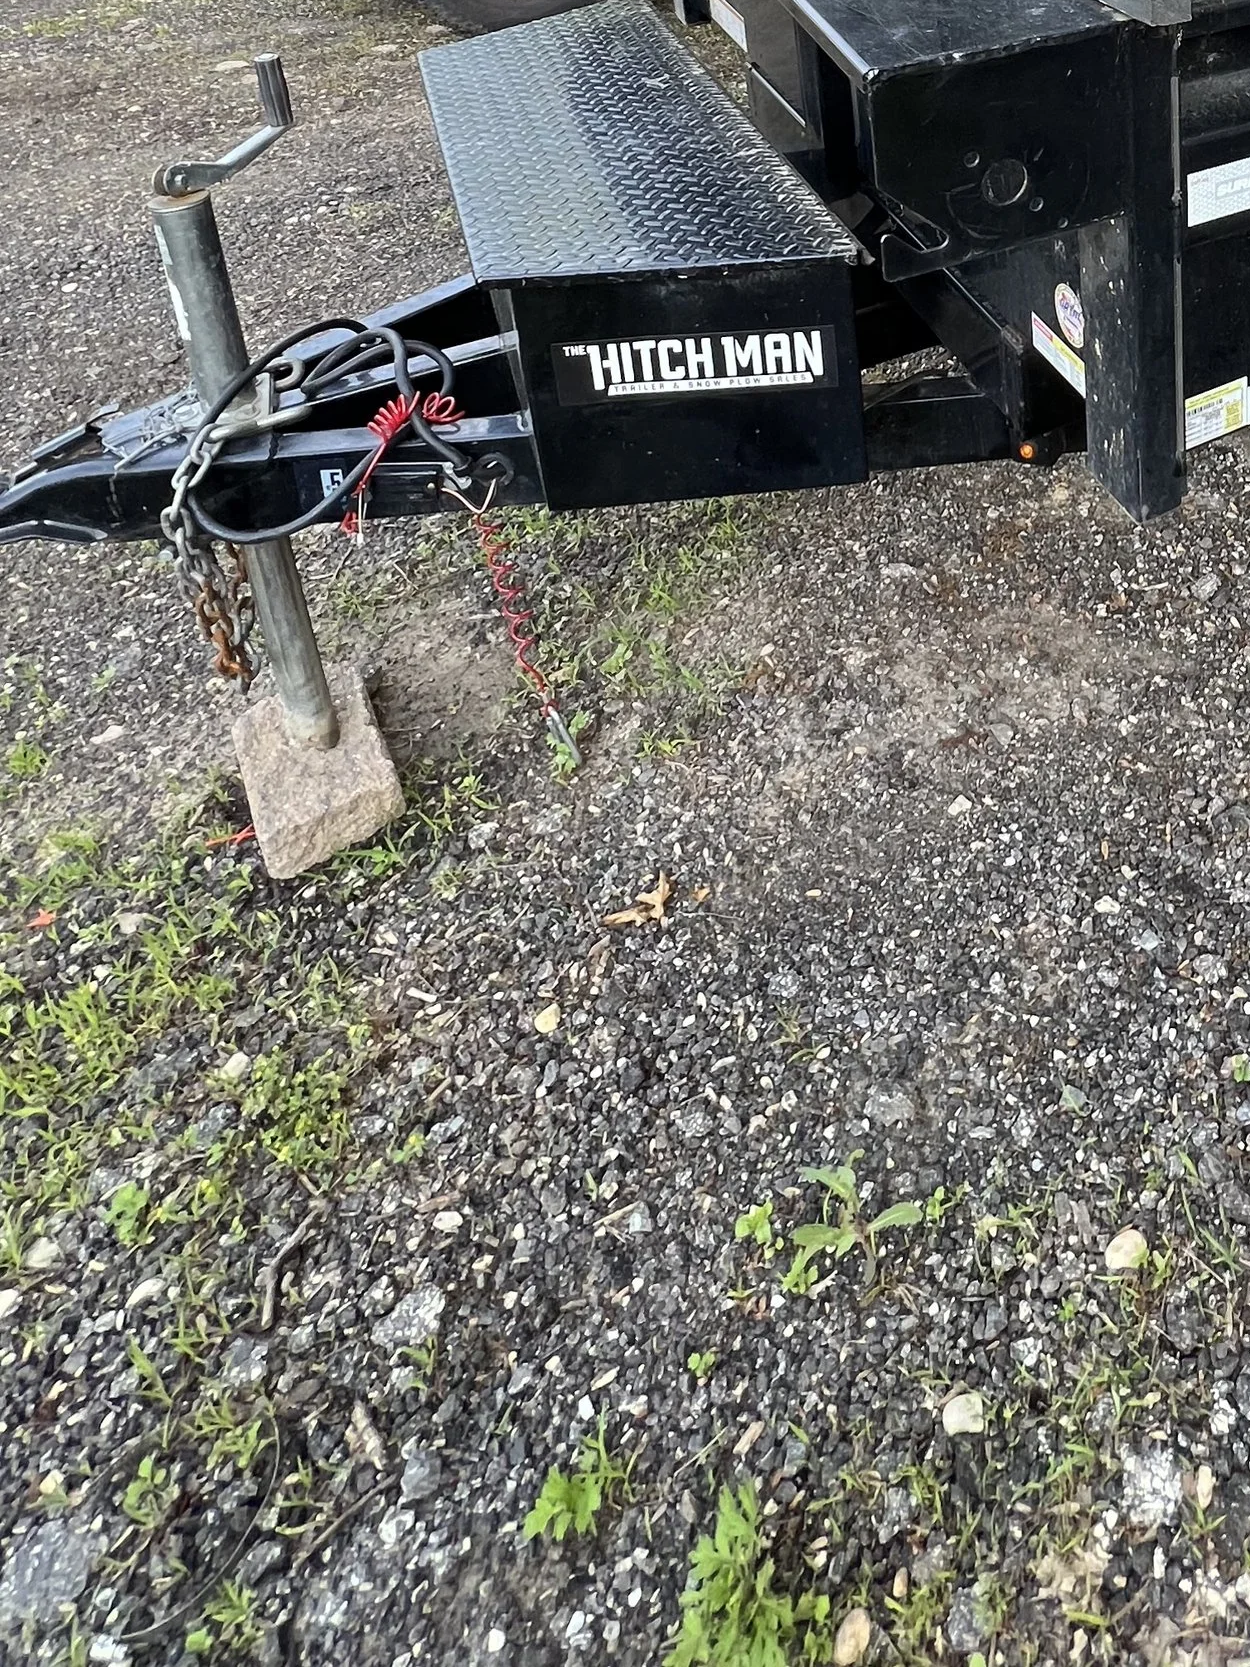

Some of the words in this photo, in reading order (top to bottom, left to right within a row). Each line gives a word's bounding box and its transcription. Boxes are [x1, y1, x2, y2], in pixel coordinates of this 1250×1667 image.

[562, 344, 586, 357] THE
[586, 337, 715, 391] HITCH
[721, 330, 823, 377] MAN
[614, 381, 664, 393] TRAILER
[688, 380, 721, 389] SNOW
[729, 375, 761, 385] PLOW
[769, 373, 807, 383] SALES
